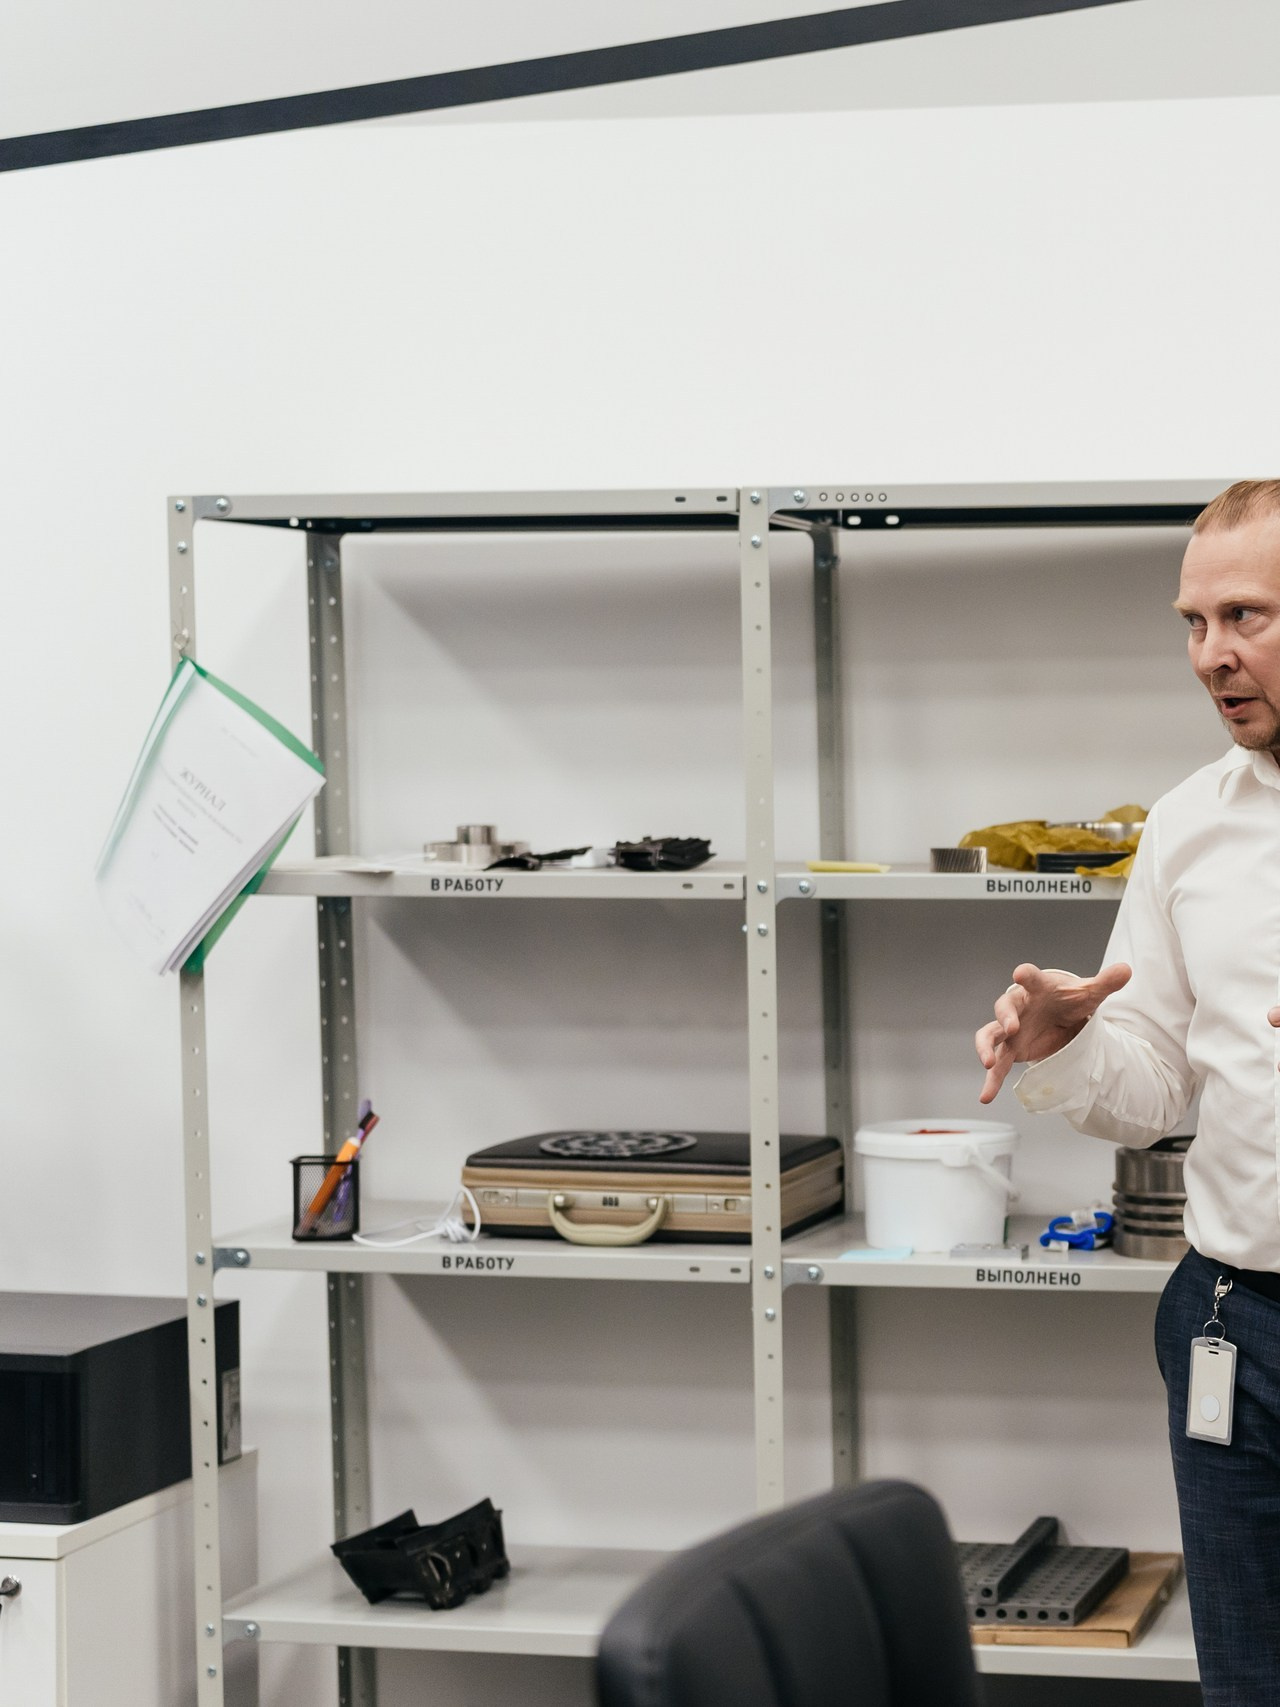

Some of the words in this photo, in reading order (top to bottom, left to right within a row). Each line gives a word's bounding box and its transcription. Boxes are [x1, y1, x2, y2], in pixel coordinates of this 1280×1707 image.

[178, 766, 227, 812] ЖУРНАЛ
[431, 878, 441, 891] В
[444, 878, 504, 892] РАБОТУ
[986, 880, 1092, 893] ВЫПОЛНЕНО
[442, 1255, 452, 1269] В
[455, 1256, 515, 1271] РАБОТУ
[976, 1269, 1081, 1286] ВЫПОЛНЕНО
